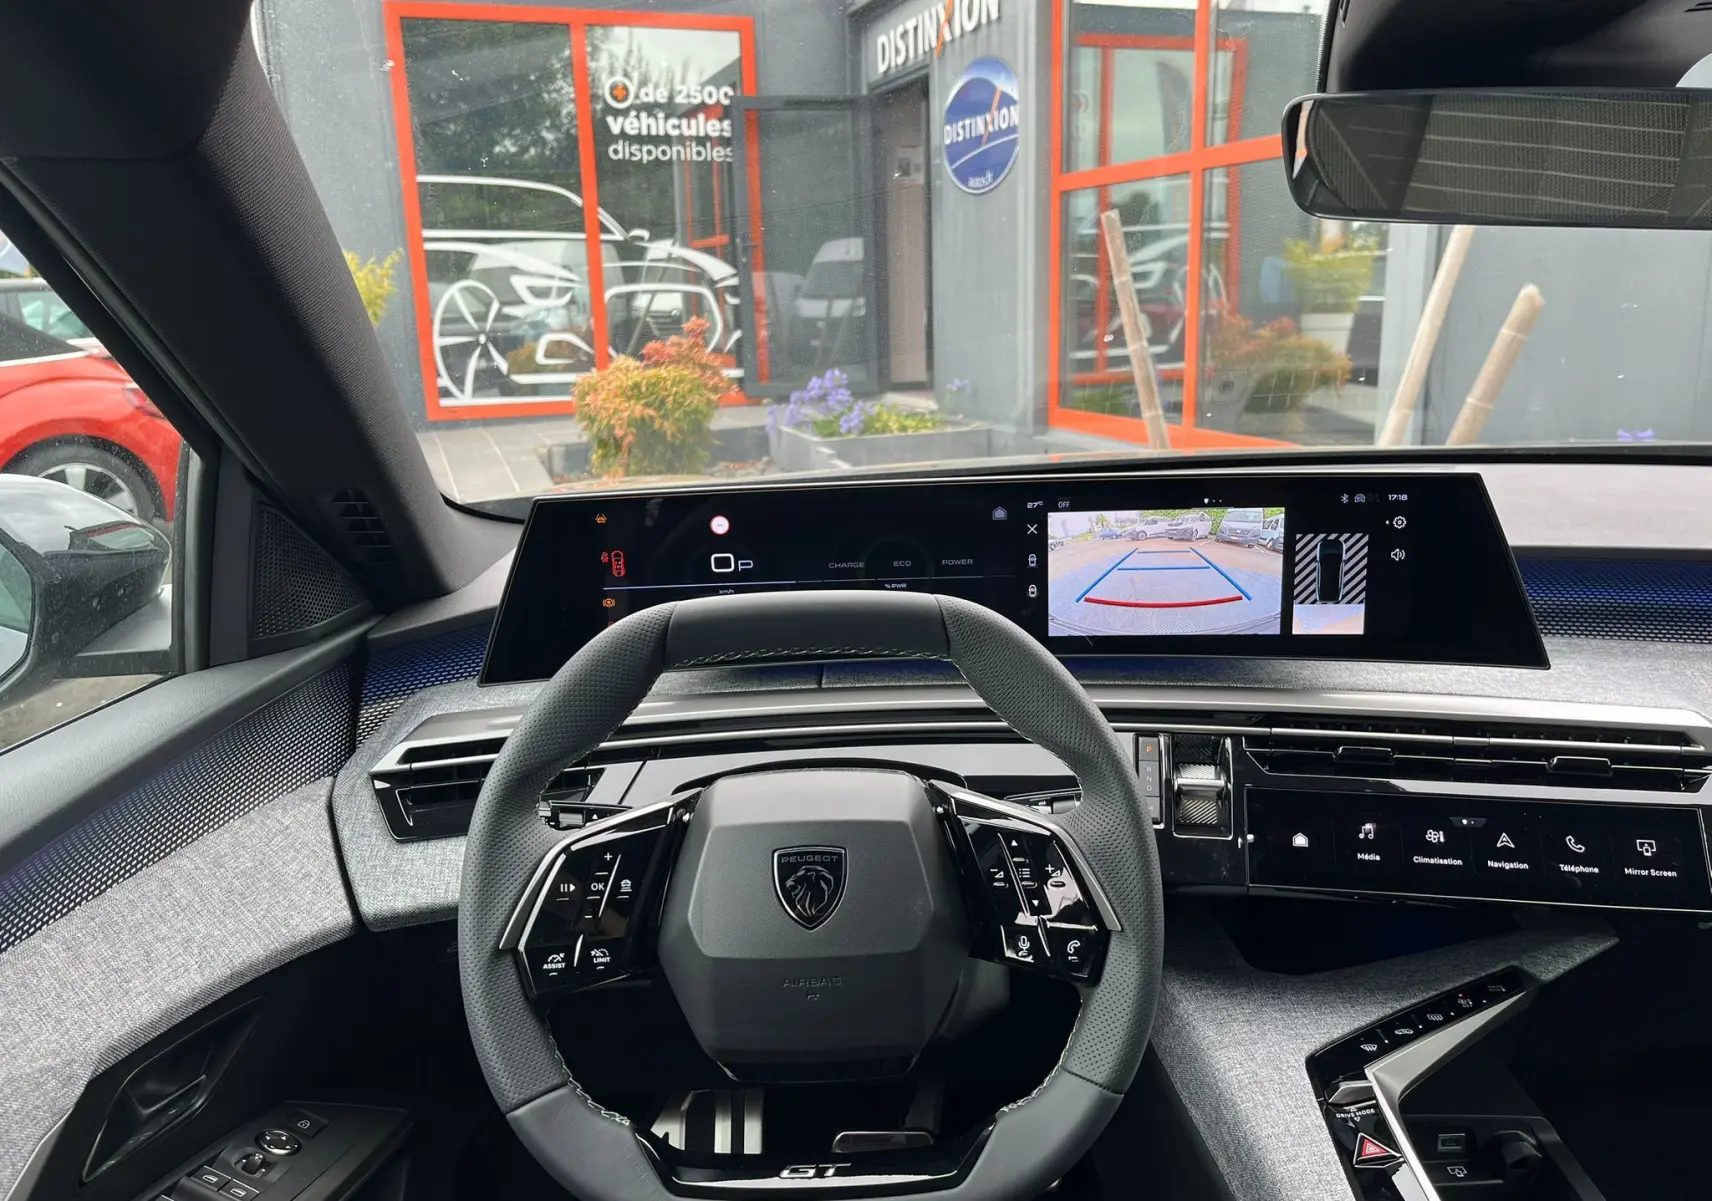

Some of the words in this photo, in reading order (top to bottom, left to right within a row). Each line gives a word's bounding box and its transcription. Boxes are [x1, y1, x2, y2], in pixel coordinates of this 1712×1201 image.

[639, 83, 670, 103] de
[605, 109, 733, 137] véhicules
[607, 139, 734, 164] disponibles
[1057, 501, 1071, 509] OFF
[738, 559, 753, 571] P
[828, 561, 865, 569] CHARGE
[941, 558, 973, 566] POWER
[781, 855, 839, 864] PEUGEOT
[1357, 852, 1381, 861] Média
[1413, 856, 1463, 866] Climatisation
[1487, 860, 1529, 870] Navigation
[1559, 864, 1600, 874] Téléphone
[1624, 867, 1649, 876] Mirror
[1650, 869, 1678, 877] Screen
[590, 882, 605, 891] OK
[542, 962, 566, 970] ASSIST
[783, 976, 842, 988] AIRBAG
[1355, 1108, 1375, 1116] MODE
[780, 1162, 851, 1178] GT
